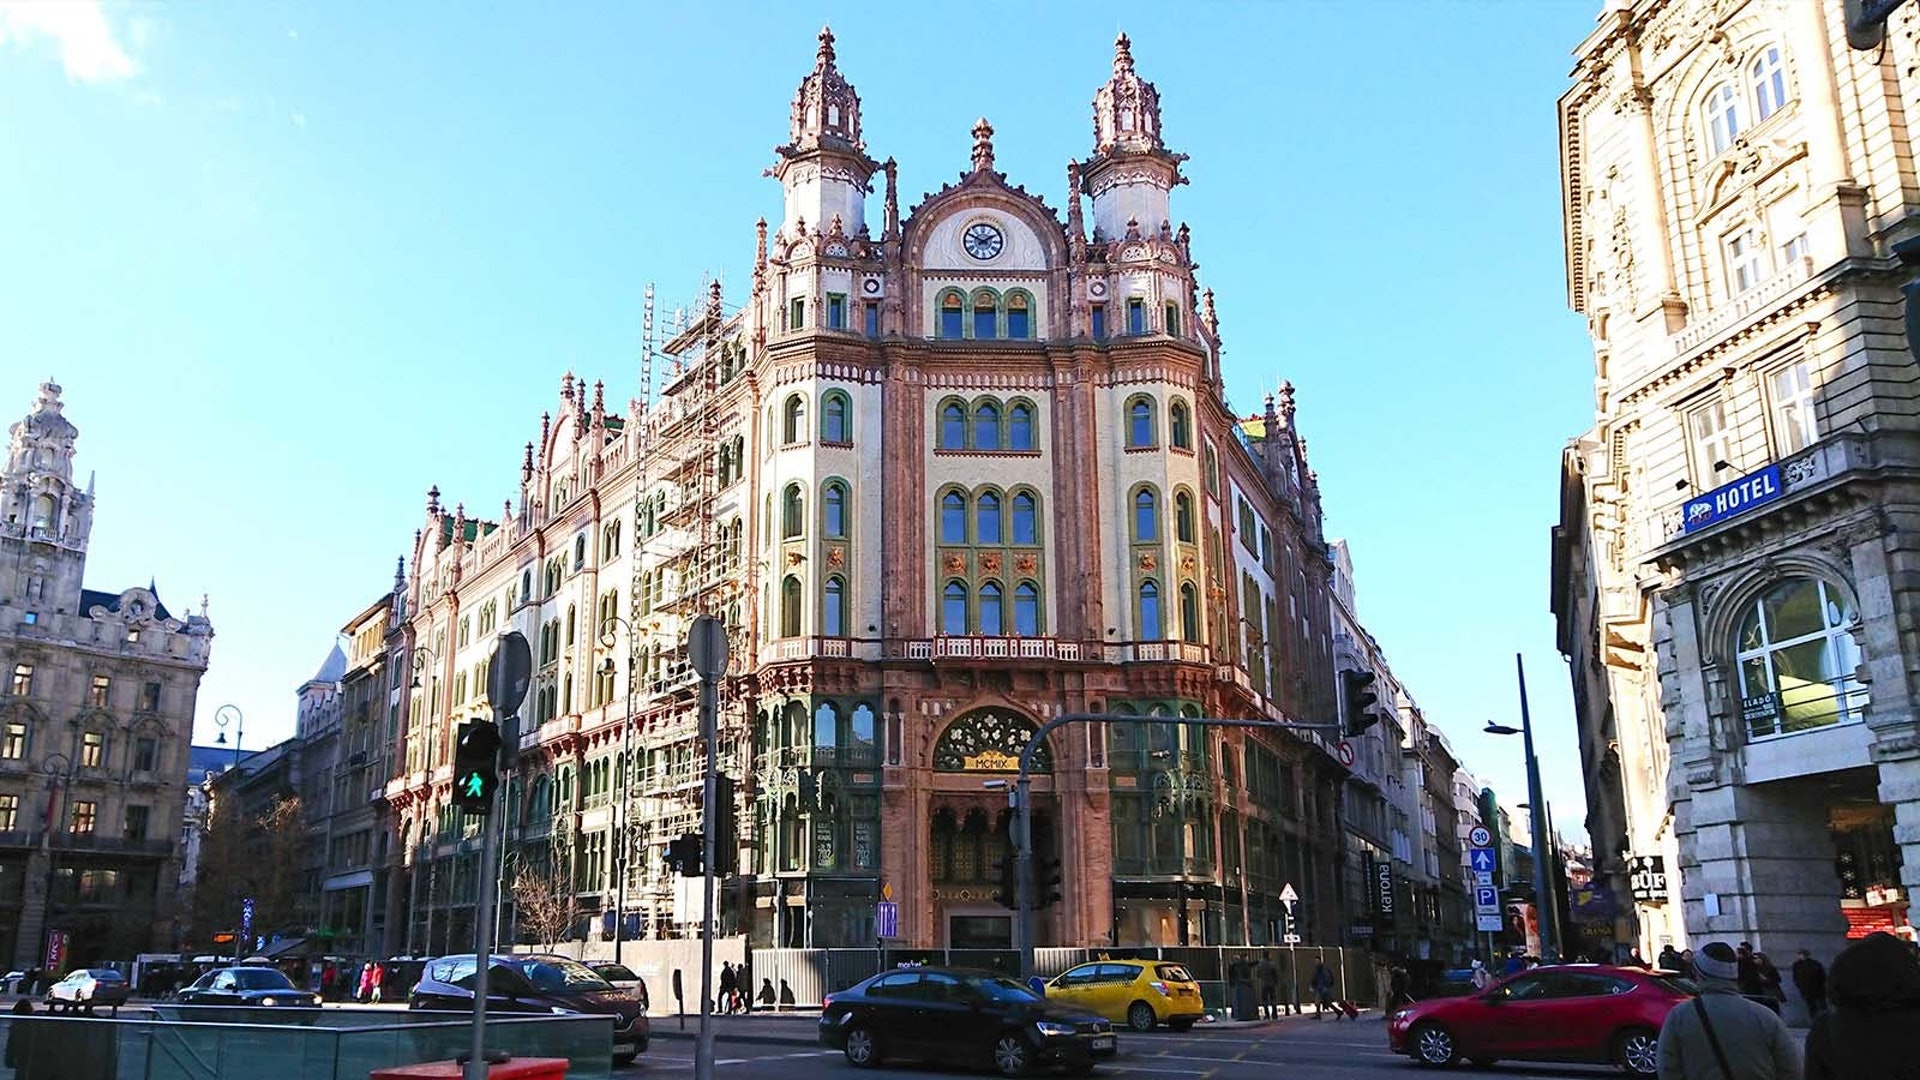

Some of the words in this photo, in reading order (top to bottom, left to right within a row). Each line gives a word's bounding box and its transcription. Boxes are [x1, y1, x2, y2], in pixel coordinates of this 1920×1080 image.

[1716, 474, 1775, 514] HOTEL
[976, 759, 1008, 769] MCMIX
[1474, 832, 1487, 842] 30
[1480, 889, 1492, 905] P
